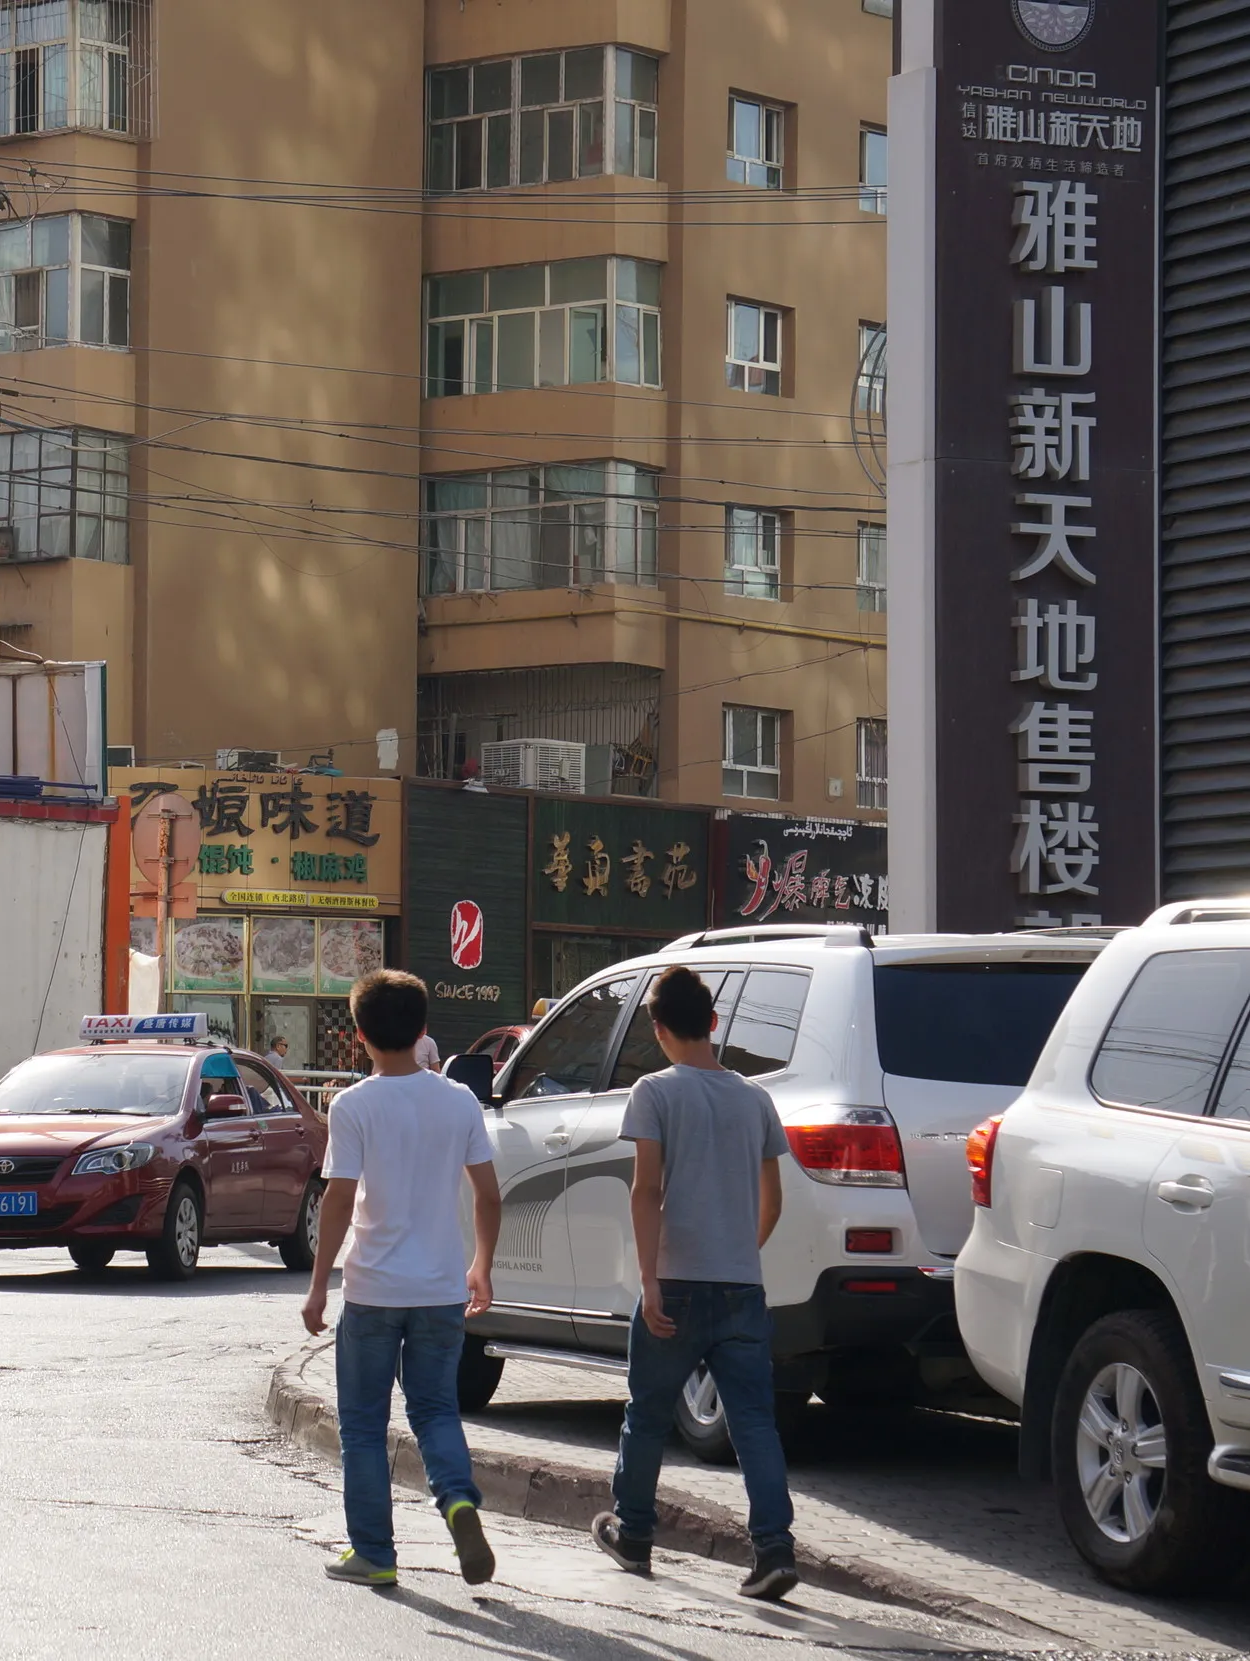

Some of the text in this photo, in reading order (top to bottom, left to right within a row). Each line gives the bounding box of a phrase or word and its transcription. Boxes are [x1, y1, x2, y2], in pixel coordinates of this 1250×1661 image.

[1008, 64, 1096, 89] CINDA
[958, 85, 1032, 101] YASHAN
[961, 102, 977, 139] 信达
[985, 104, 1142, 152] 雅山新天地
[1011, 180, 1100, 927] 雅山新天地售楼
[434, 981, 475, 1000] SINCE
[86, 1017, 134, 1029] TAXI
[492, 1260, 544, 1273] IGHLANDER
